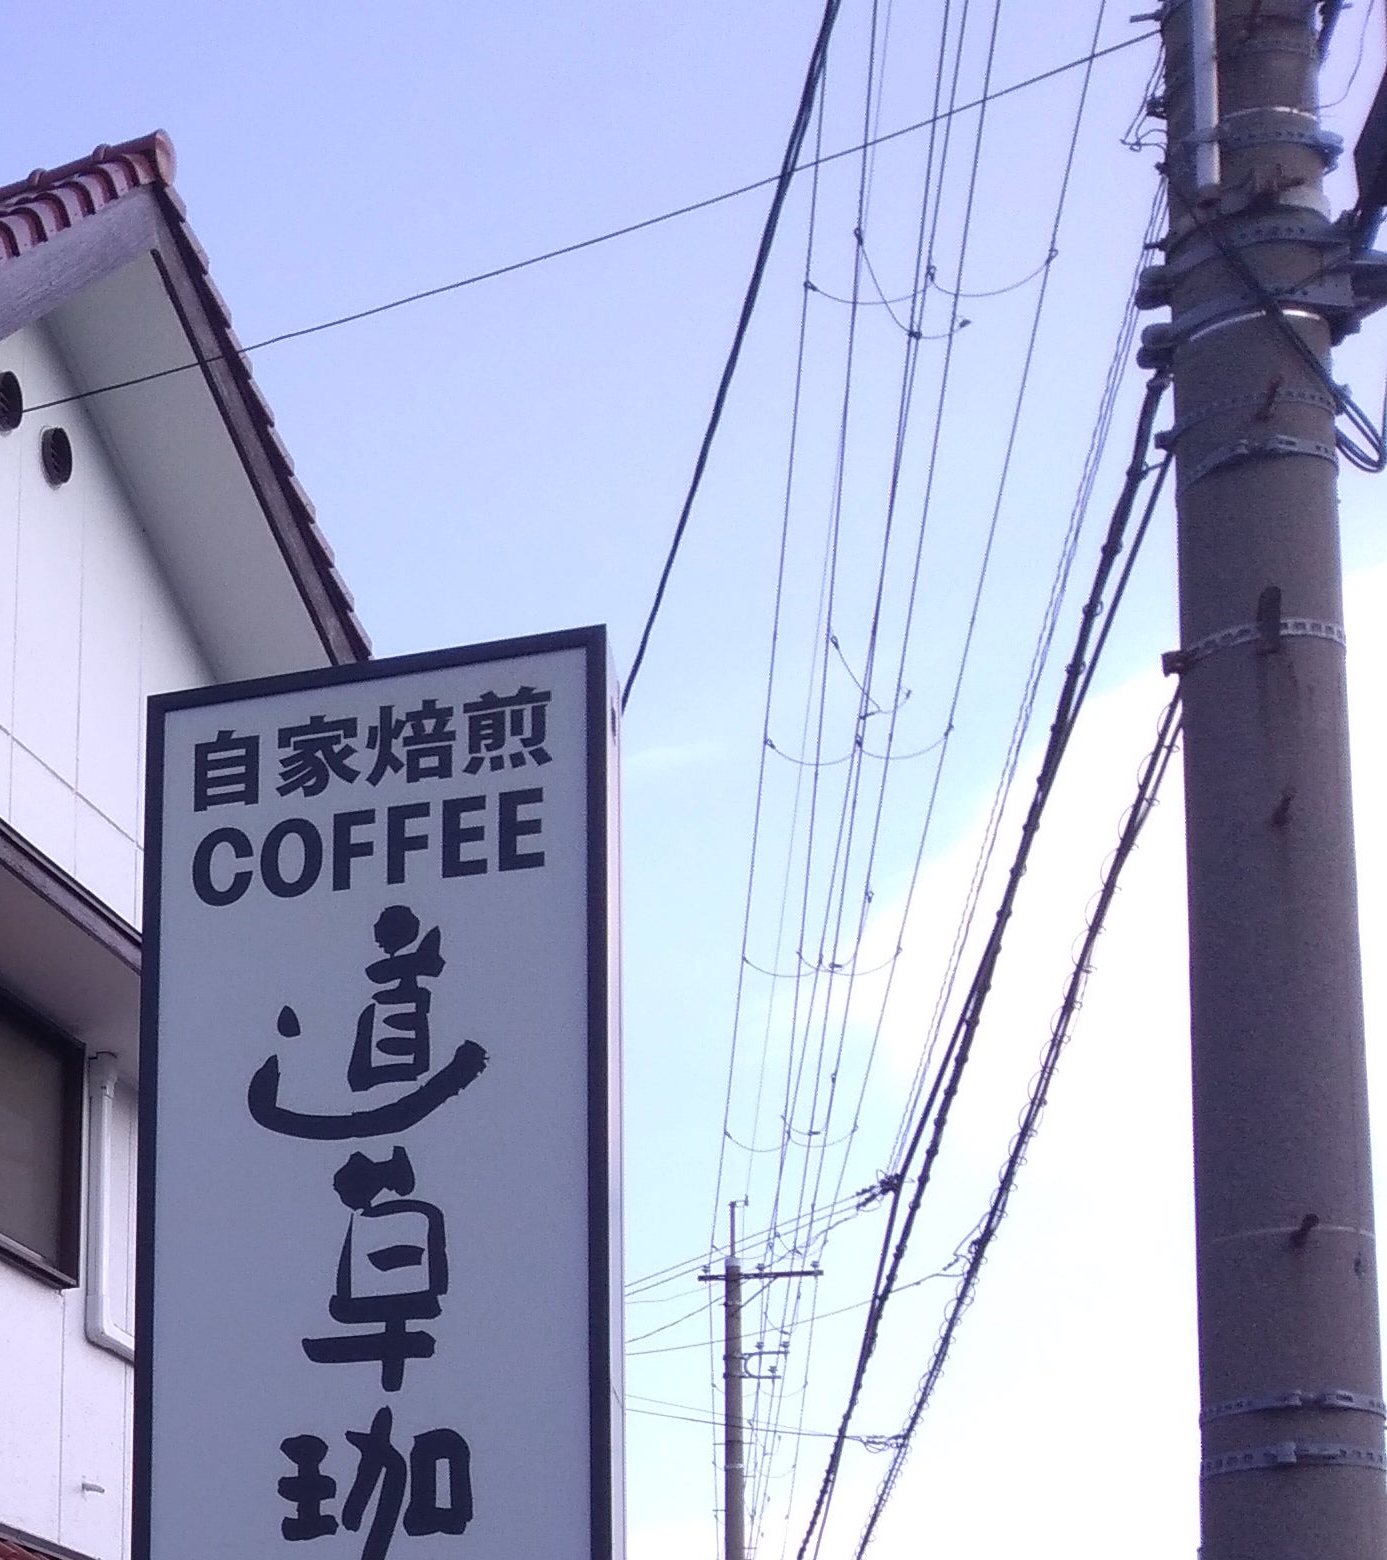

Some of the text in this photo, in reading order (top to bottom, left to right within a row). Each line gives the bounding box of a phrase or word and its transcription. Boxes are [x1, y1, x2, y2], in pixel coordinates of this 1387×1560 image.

[192, 686, 553, 813] 自家焙煎
[191, 786, 546, 907] COFFEE
